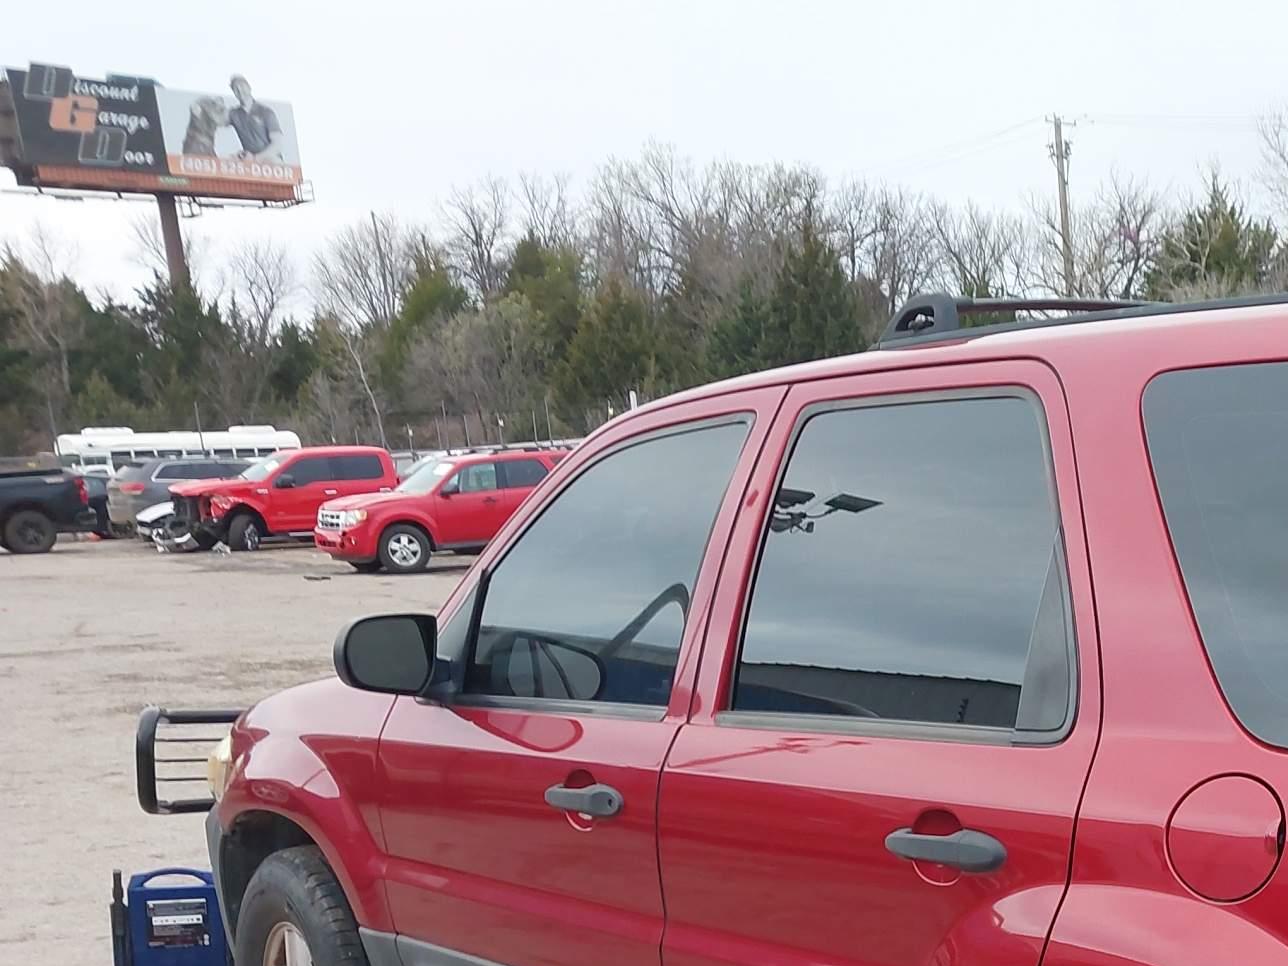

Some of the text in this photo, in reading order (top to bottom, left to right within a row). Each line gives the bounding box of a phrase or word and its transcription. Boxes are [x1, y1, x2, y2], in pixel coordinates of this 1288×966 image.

[23, 63, 140, 102] Discount
[49, 95, 150, 135] Garage
[78, 127, 155, 167] Door
